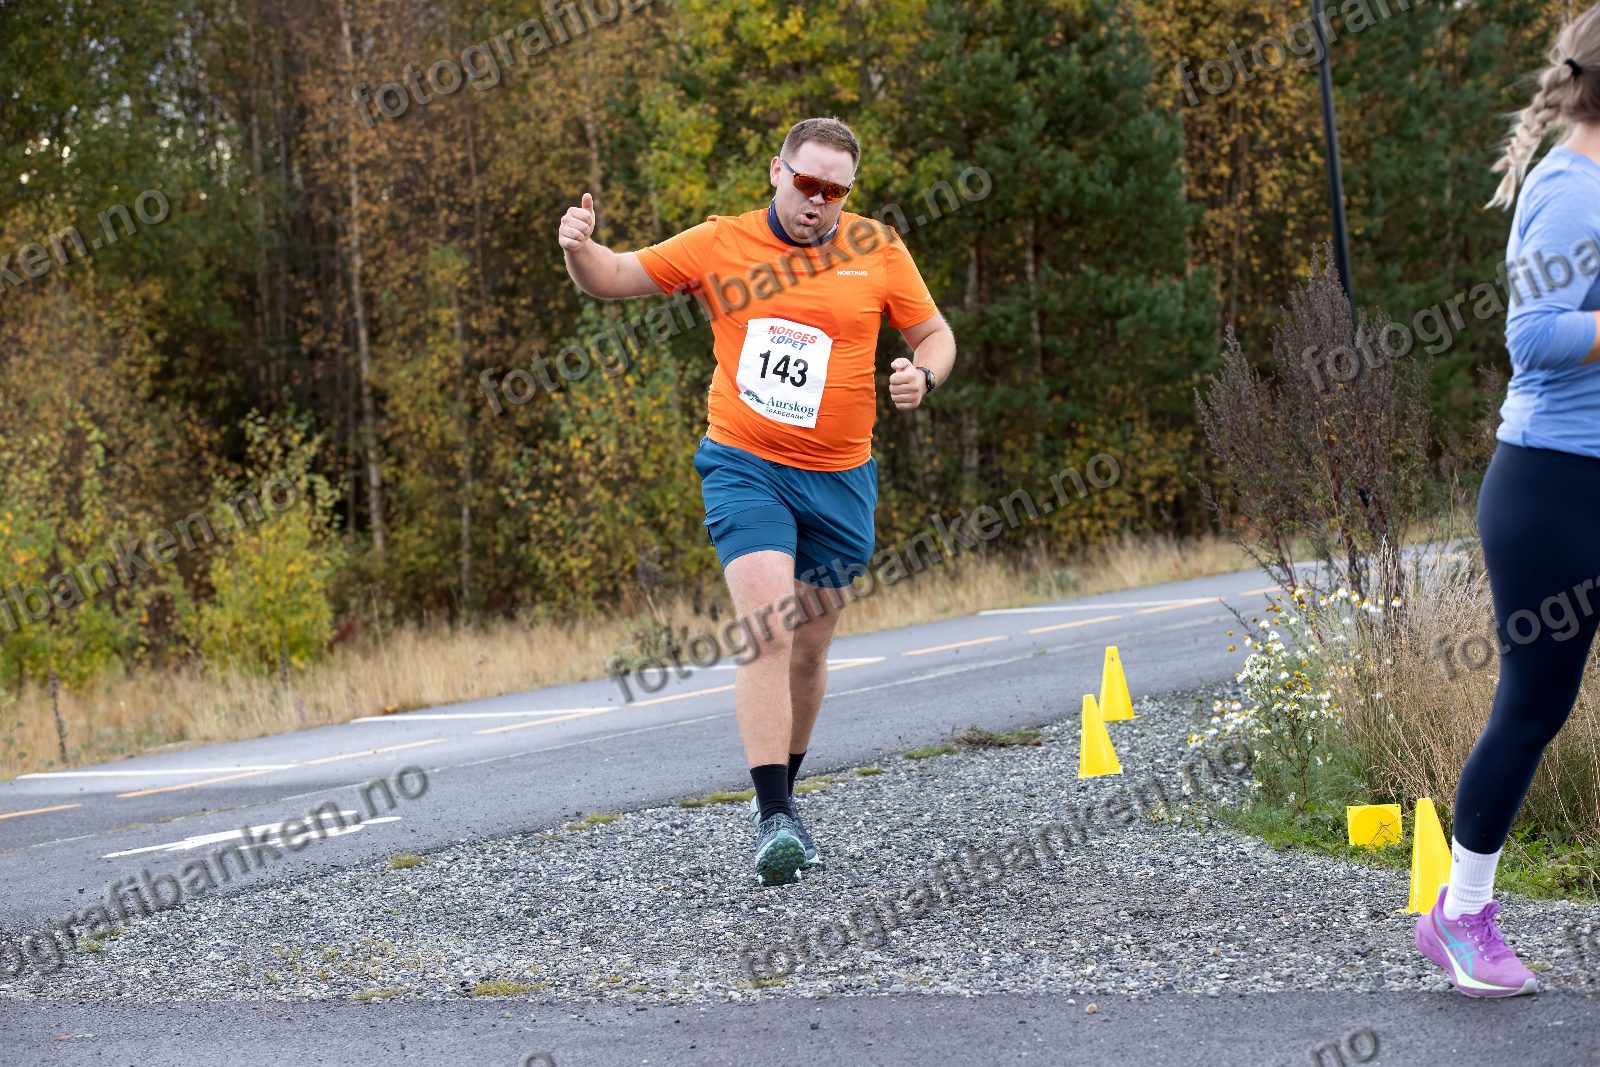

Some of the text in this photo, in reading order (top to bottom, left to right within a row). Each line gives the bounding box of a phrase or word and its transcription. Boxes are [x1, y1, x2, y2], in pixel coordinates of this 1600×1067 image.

[768, 325, 818, 344] NORGES
[770, 335, 807, 350] LØPET
[759, 349, 809, 388] 143
[766, 396, 815, 417] Aurskog
